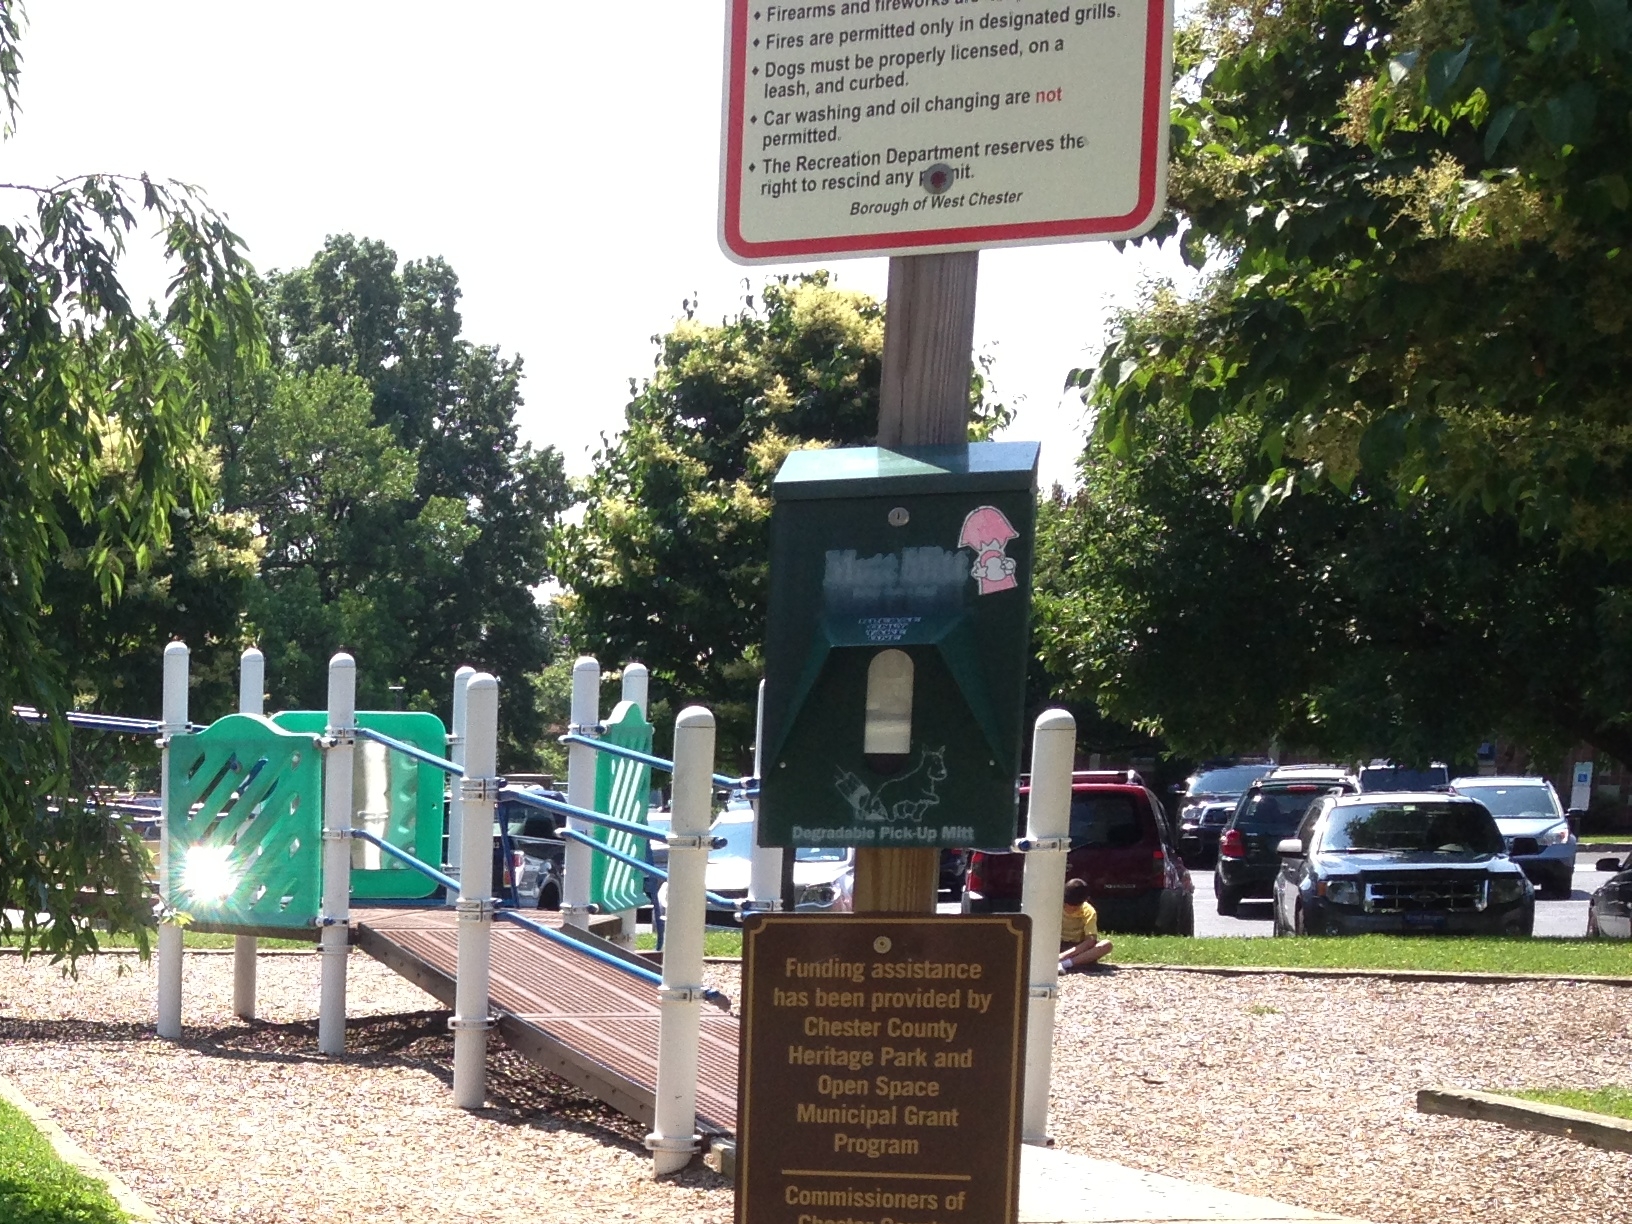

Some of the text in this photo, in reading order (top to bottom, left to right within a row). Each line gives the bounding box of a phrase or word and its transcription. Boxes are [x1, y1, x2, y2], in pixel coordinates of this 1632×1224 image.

[768, 3, 836, 22] Firearms
[841, 0, 870, 15] and
[766, 3, 1120, 49] Fires are permitted only in designated grills.
[766, 38, 1064, 80] Dogs must be properly licensed, on a
[764, 71, 909, 99] leash, and curbed.
[764, 86, 1062, 126] Car washing and oil changing are not
[763, 126, 841, 151] permitted.
[763, 133, 1086, 174] The Recreation Department reserves the
[761, 178, 797, 198] right
[802, 178, 816, 192] to
[822, 171, 881, 191] rescind
[886, 170, 914, 188] any
[850, 191, 1023, 216] Borough of West Chester
[792, 825, 974, 842] Degradable Pick-Up Mitt
[785, 958, 982, 982] Funding assistance
[774, 988, 992, 1014] has been provided by
[804, 1016, 958, 1042] Chester County
[789, 1046, 972, 1070] Heritage Park and
[818, 1075, 940, 1100] Open Space
[798, 1104, 959, 1128] Municipal Grant
[834, 1133, 919, 1157] Program
[785, 1185, 965, 1210] Commissioners of
